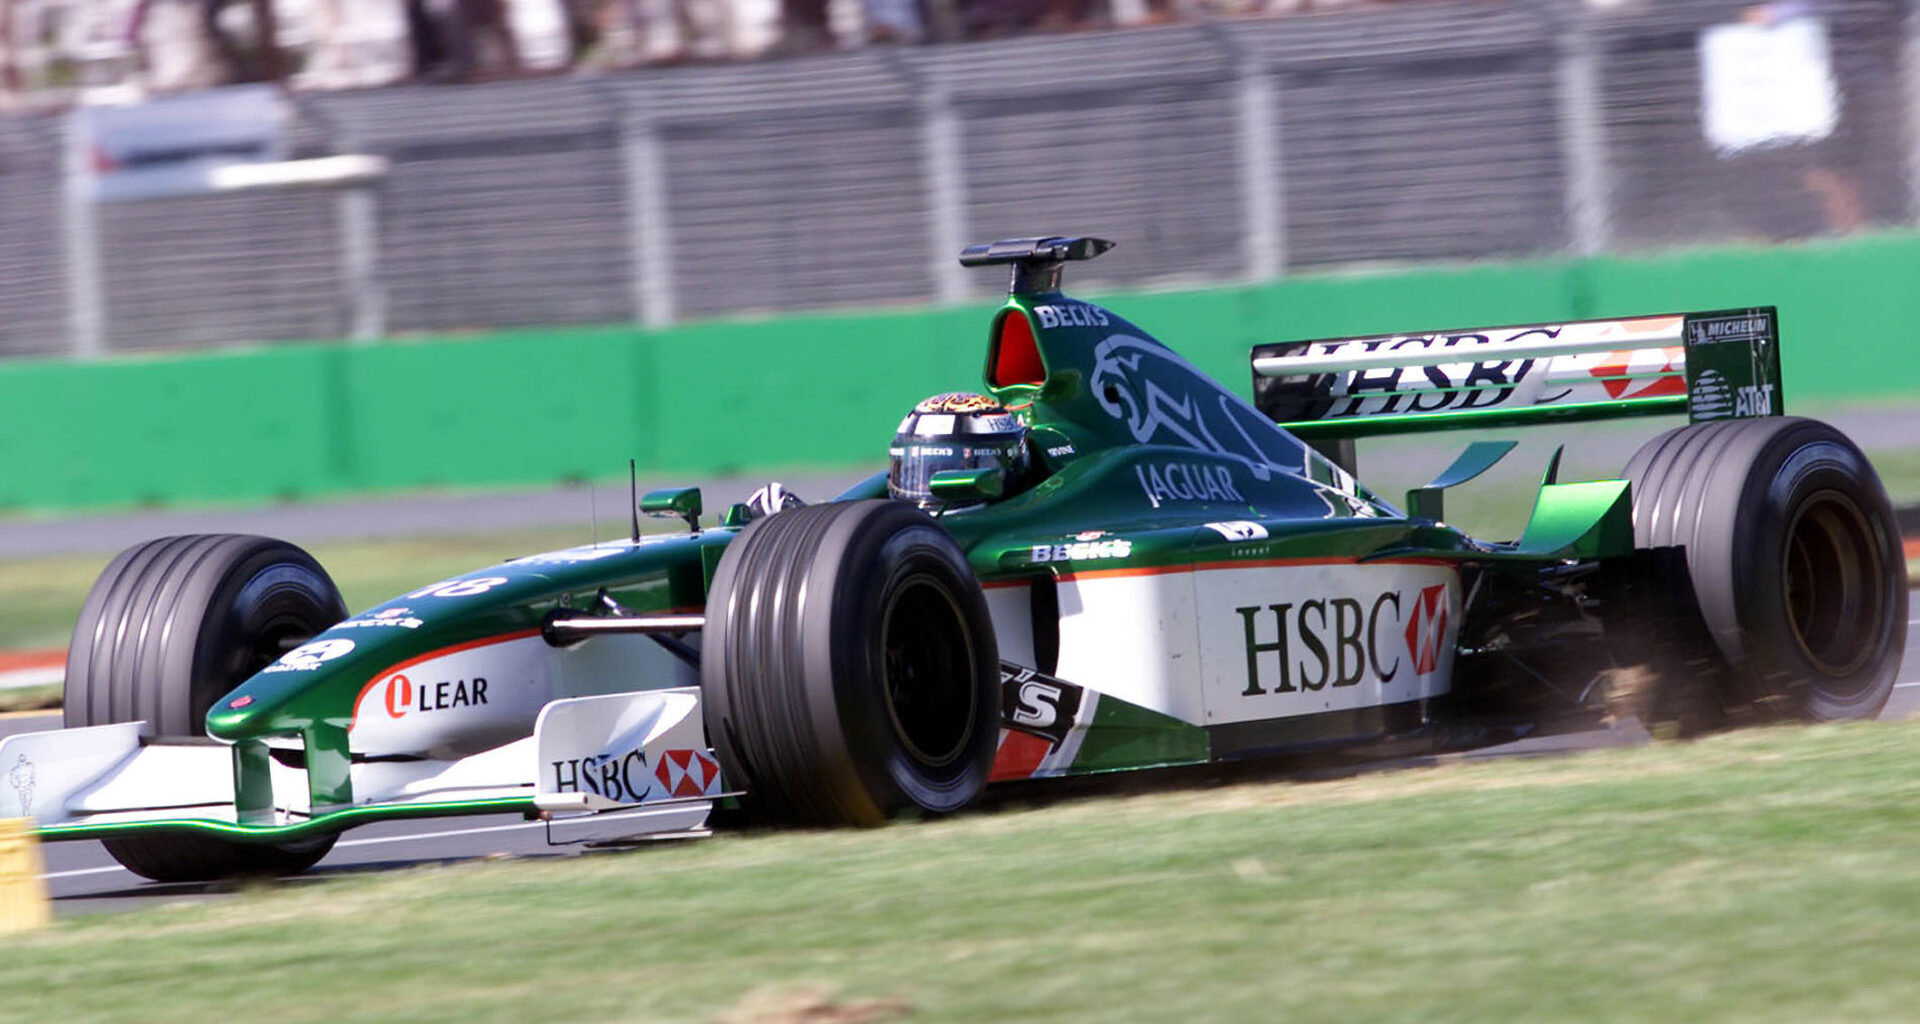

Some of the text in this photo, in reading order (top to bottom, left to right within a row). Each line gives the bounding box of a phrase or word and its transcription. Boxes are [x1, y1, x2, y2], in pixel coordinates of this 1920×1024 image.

[1707, 318, 1767, 336] MICHELIN
[1735, 384, 1773, 417] AT&T
[1135, 462, 1246, 509] JAGUAR
[406, 576, 509, 599] 18
[1235, 590, 1401, 697] HSBC
[419, 677, 489, 712] LEAR
[552, 749, 651, 801] HSBC
